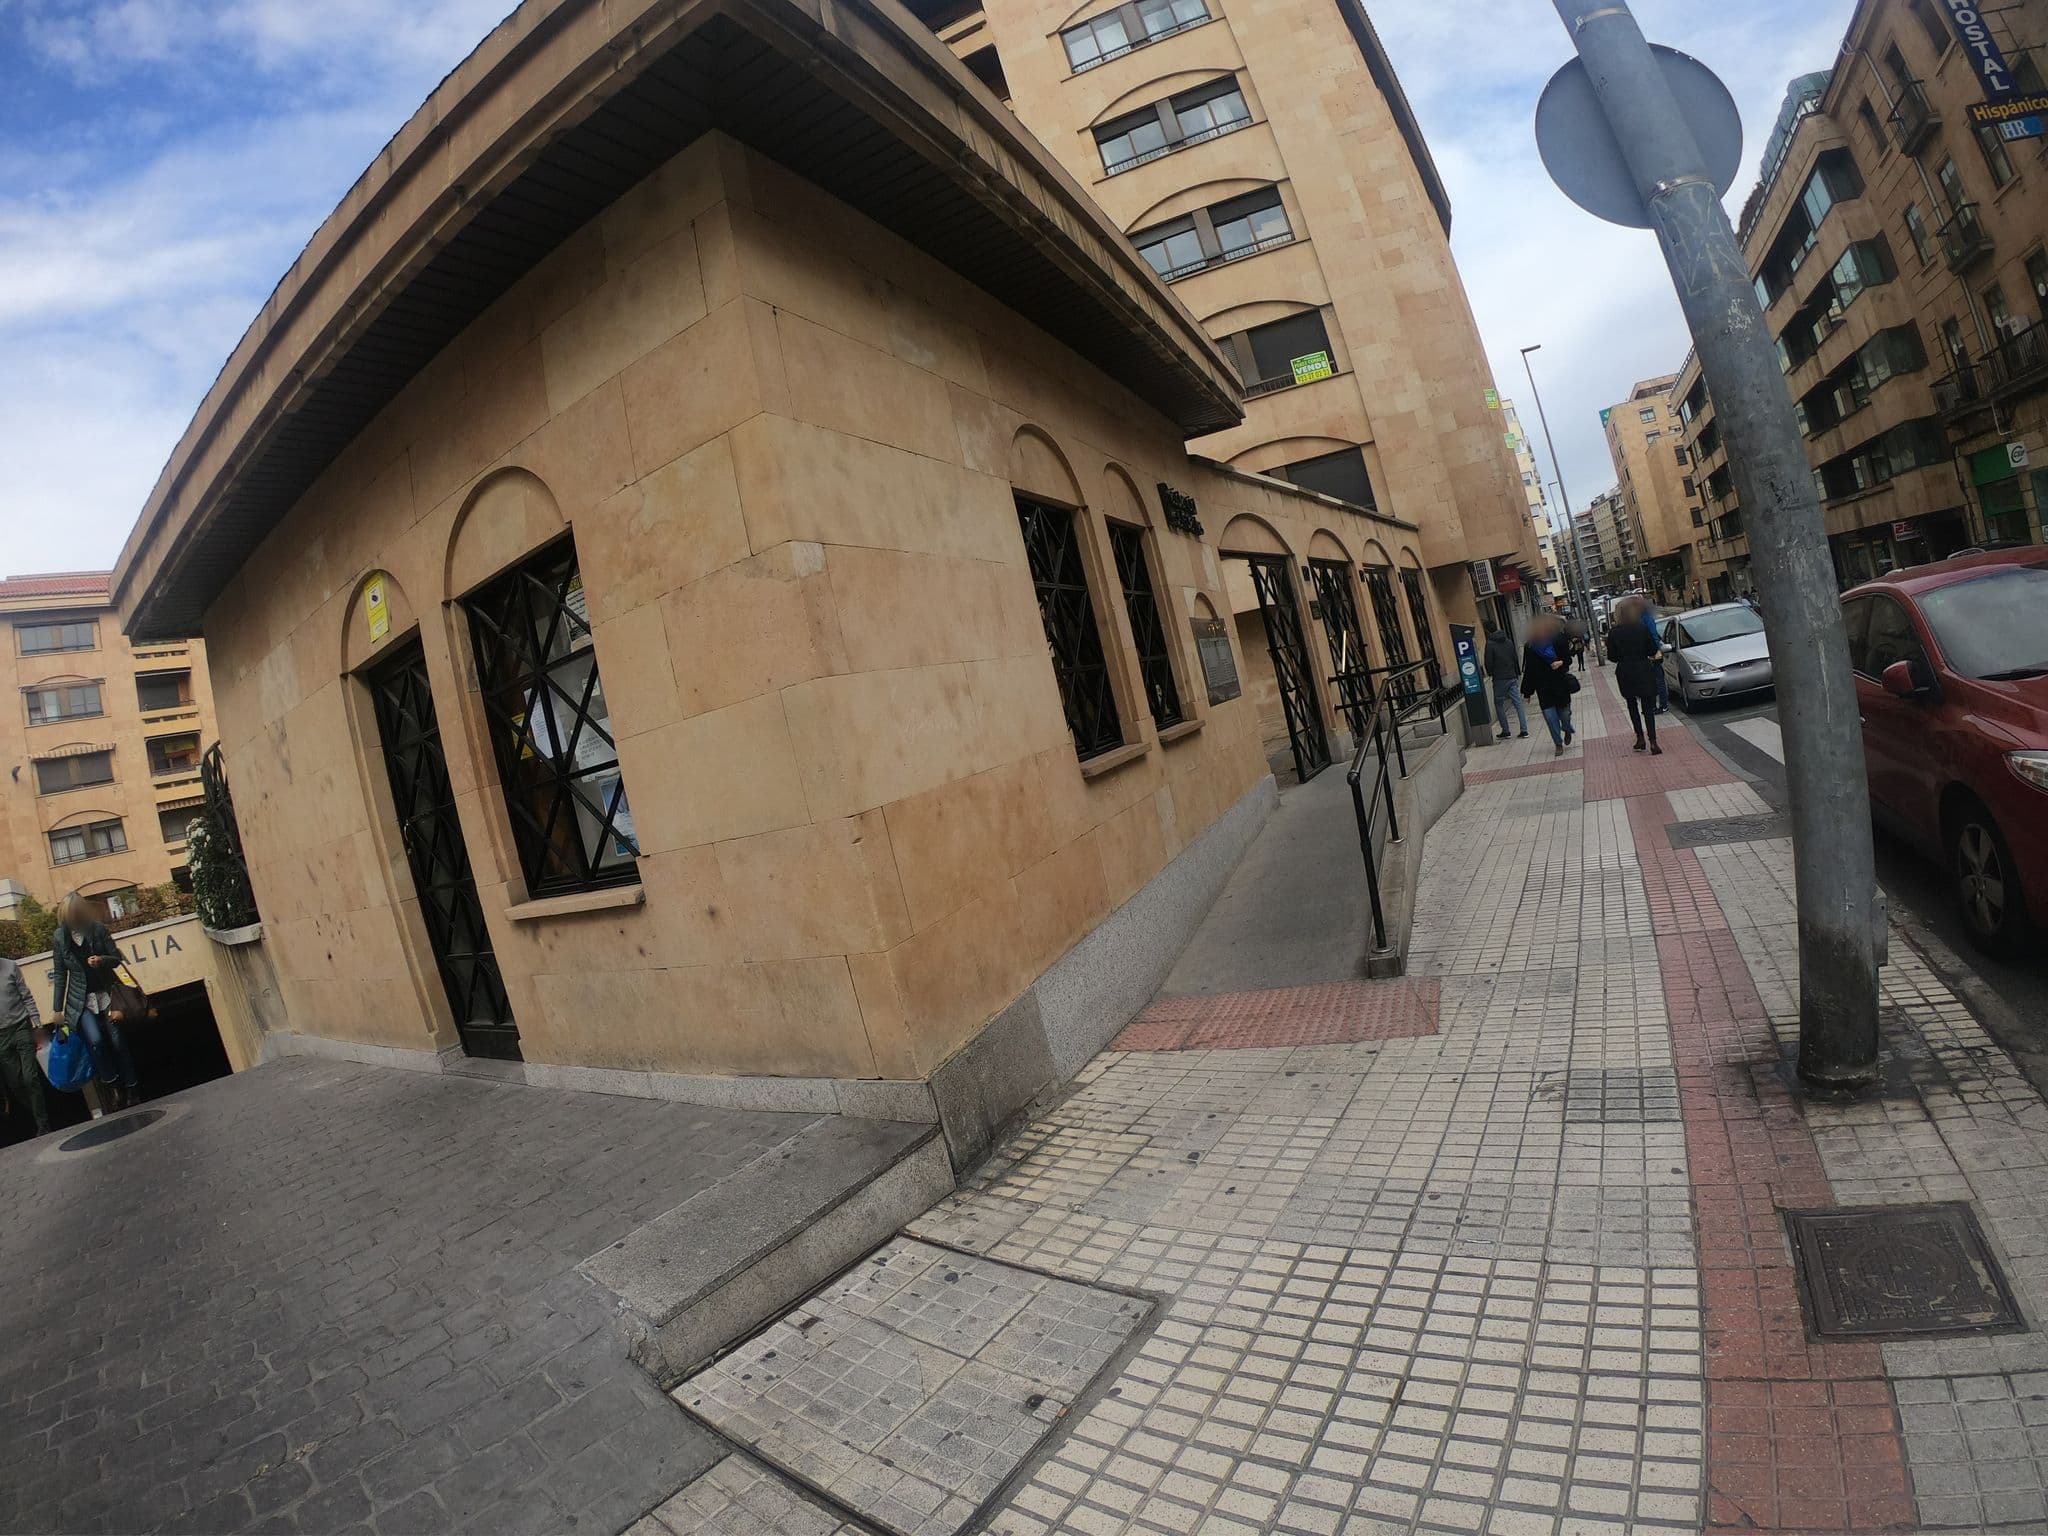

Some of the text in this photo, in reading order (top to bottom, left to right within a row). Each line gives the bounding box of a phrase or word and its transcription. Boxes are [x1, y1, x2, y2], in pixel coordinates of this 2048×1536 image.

[1948, 0, 2010, 91] HOSTAL
[1973, 97, 2048, 120] Hispánico
[2003, 120, 2029, 139] HR
[1295, 361, 1328, 374] VENDE
[1458, 641, 1469, 655] P
